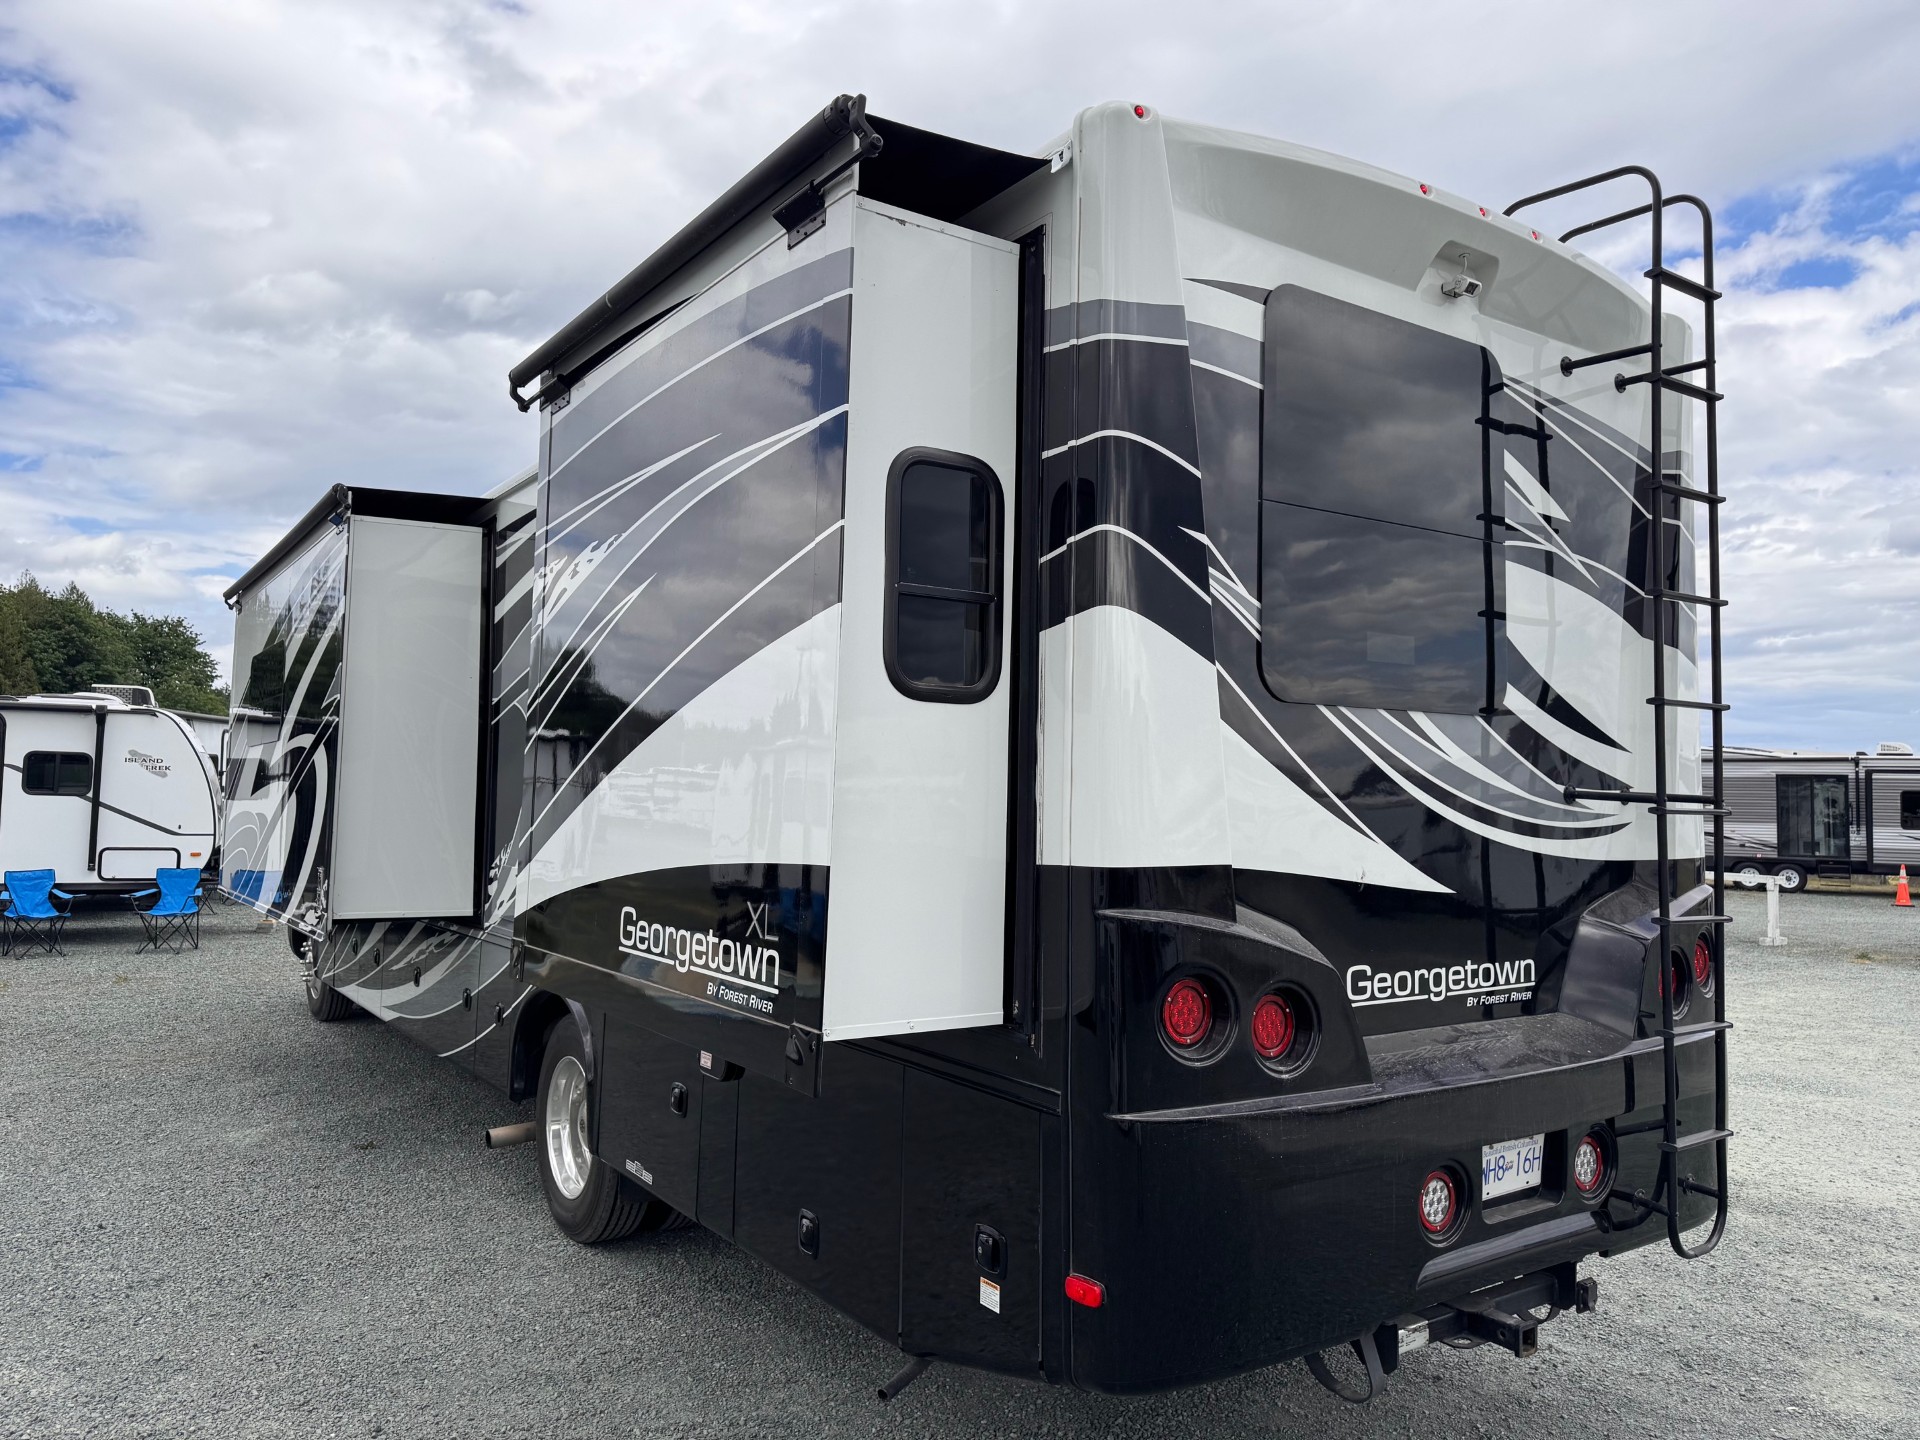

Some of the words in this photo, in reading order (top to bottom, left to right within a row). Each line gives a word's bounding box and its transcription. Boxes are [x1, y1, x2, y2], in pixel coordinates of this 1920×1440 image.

[745, 901, 780, 942] XL
[619, 906, 780, 986] Georgetown
[706, 982, 718, 996] BY
[718, 985, 748, 1007] FOREST
[749, 994, 773, 1014] RIVER
[1346, 958, 1535, 1002] Georgetown
[1466, 996, 1478, 1007] BY
[1479, 993, 1508, 1005] FOREST
[1510, 991, 1532, 1002] RIVER
[1516, 1145, 1541, 1176] 16H
